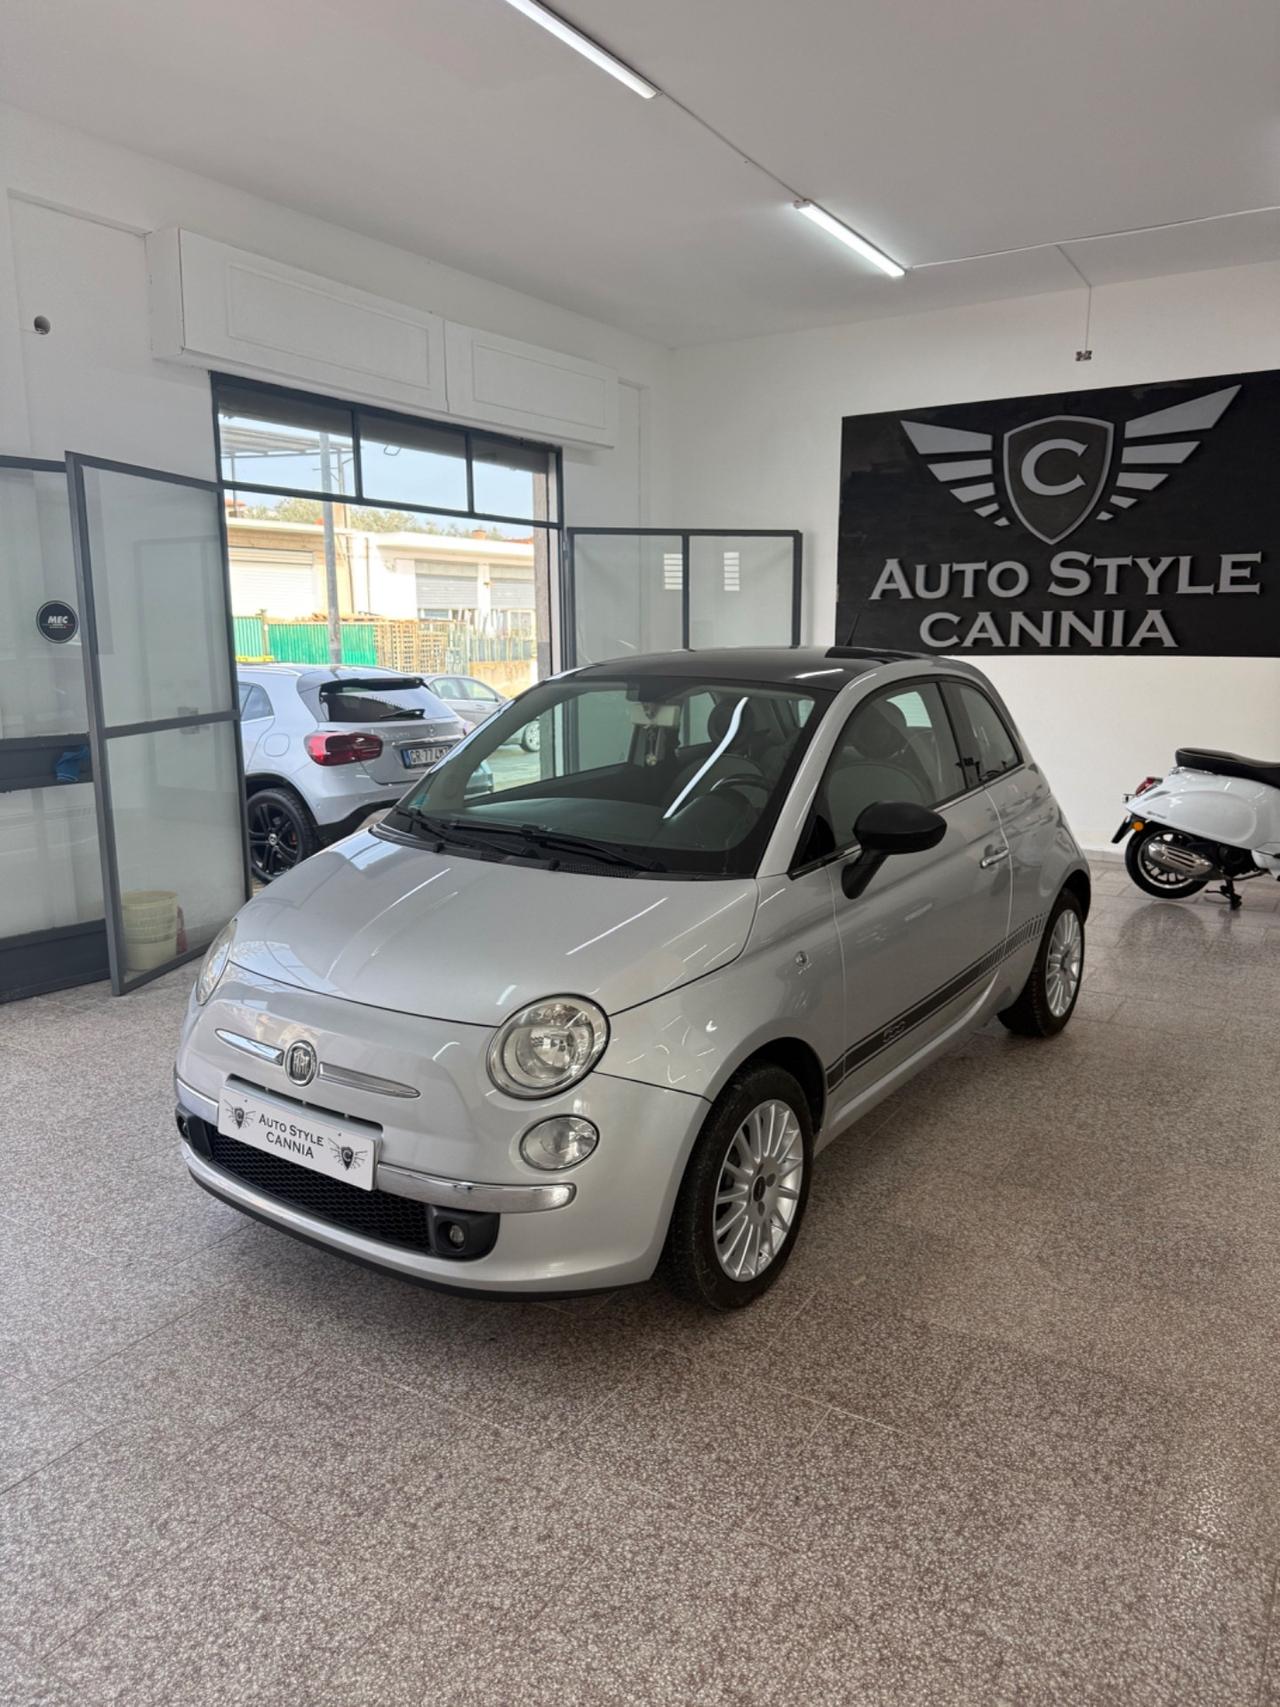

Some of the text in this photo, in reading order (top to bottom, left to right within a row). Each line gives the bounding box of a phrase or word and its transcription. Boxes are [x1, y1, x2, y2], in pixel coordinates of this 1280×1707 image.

[1021, 438, 1088, 496] C
[868, 551, 1262, 600] AUTO STYLE
[47, 615, 68, 624] MEC
[919, 609, 1178, 648] CANNIA
[258, 1114, 324, 1147] AUTO STYLE
[266, 1131, 314, 1159] CANNIA
